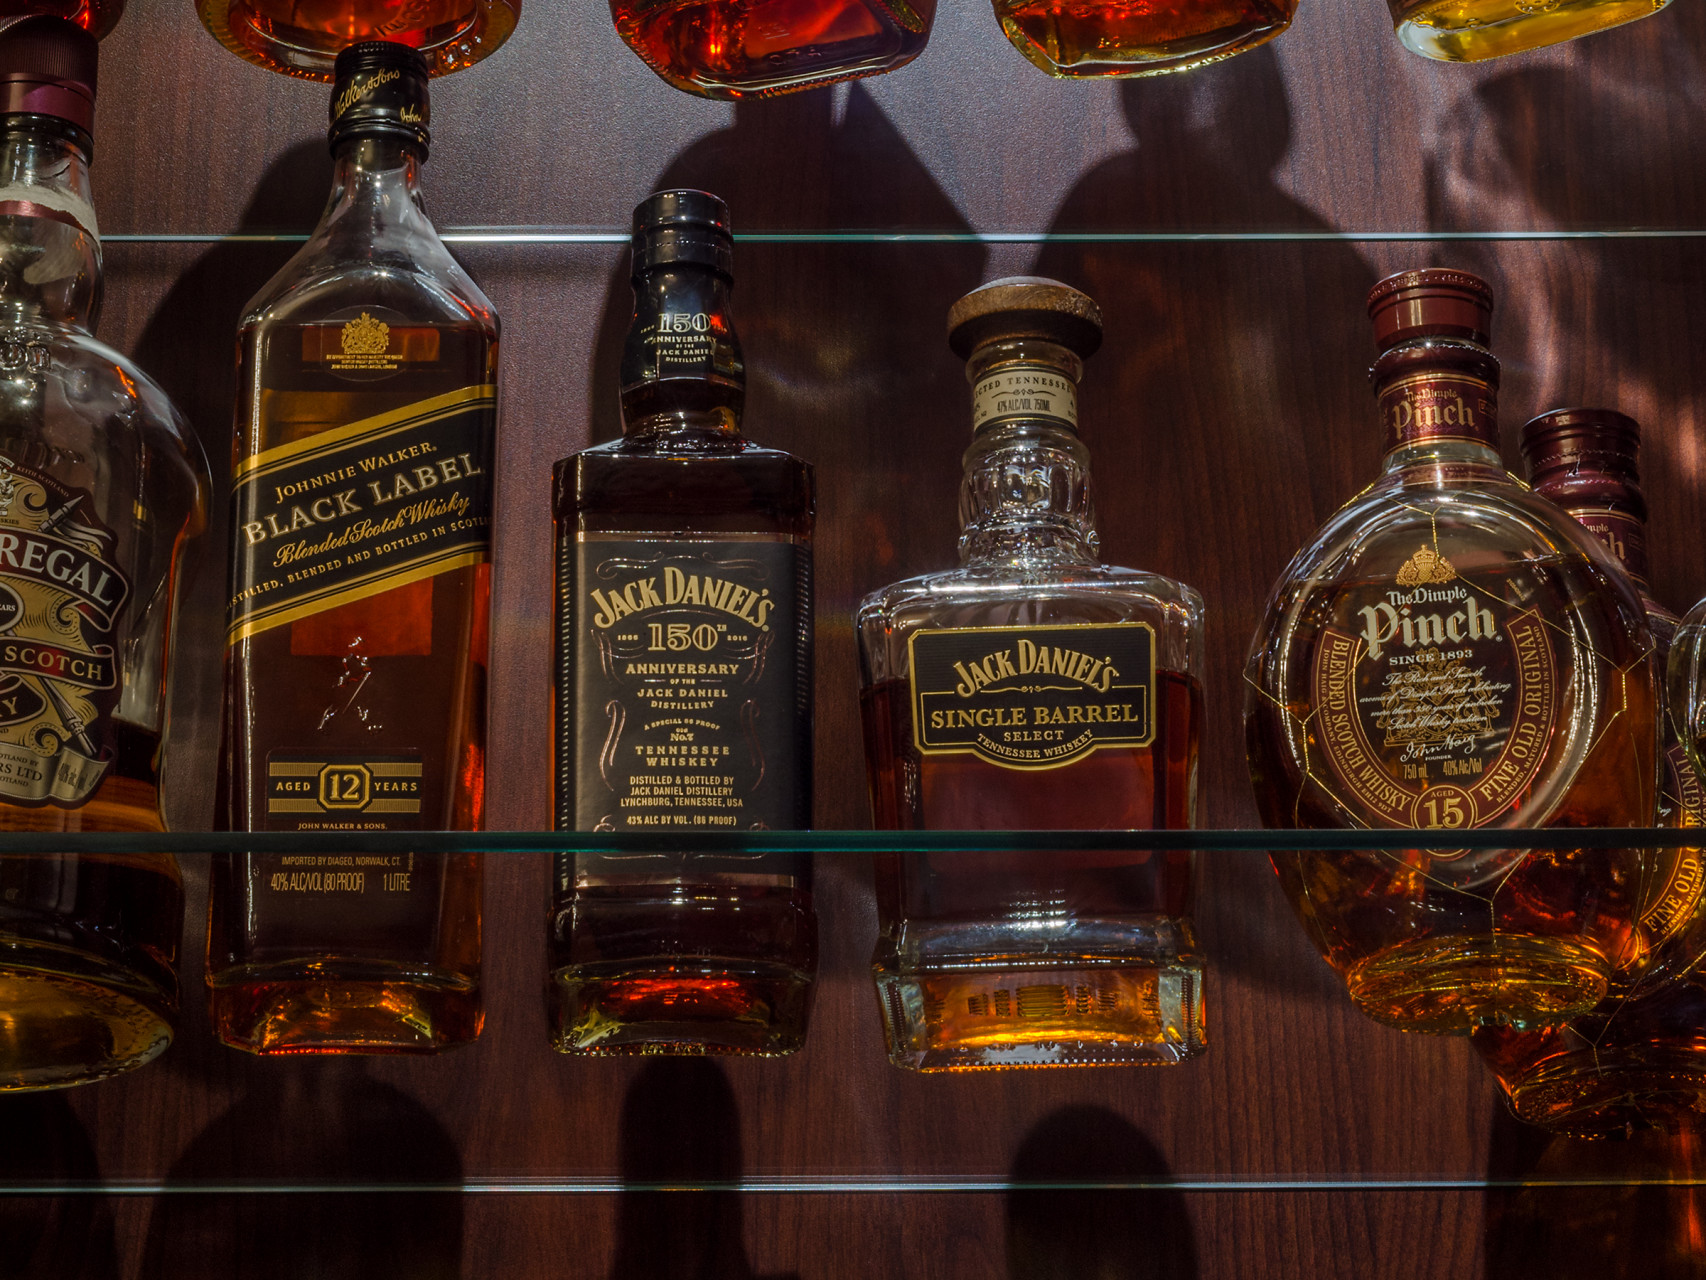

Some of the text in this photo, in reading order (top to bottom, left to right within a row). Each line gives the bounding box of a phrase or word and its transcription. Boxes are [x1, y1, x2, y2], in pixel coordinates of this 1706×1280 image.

[657, 313, 711, 333] 150
[275, 466, 355, 504] JOHNNIE
[241, 453, 481, 544] BLACK LABEL
[273, 492, 469, 568] Blended Scotch Whisky
[288, 526, 446, 583] BLENDED AND BOTTLED IN
[0, 533, 113, 606] REGAL
[591, 567, 775, 629] JACK DANIEL'S
[1386, 587, 1467, 606] The Dimple
[648, 624, 718, 651] 150
[1358, 596, 1497, 661] Pinch
[5, 646, 102, 681] SCOTCH
[626, 664, 739, 674] ANNIVERSARY
[953, 639, 1120, 697] JACK DANIEL'S
[1390, 650, 1473, 665] SINCE 1893
[638, 689, 727, 697] JACK DANIEL
[651, 701, 714, 710] DISTILLERY
[931, 704, 1138, 729] SINGLE BARREL
[1329, 640, 1411, 812] BLENDED SCOTCH WHISKY
[1480, 626, 1542, 801] FINE OLD ORIGINAL
[977, 729, 1093, 758] TENNESSEE WHISKEY
[1003, 731, 1064, 742] SELECT
[636, 746, 730, 755] TENNESSEE
[646, 758, 718, 766] WHISKEY
[276, 774, 417, 800] AGED 12 YEARS
[630, 776, 734, 784] DISTILLED & BOTTLED BY
[630, 787, 733, 795] JACK DANIEL DISTILLERY
[621, 798, 743, 807] LYNCHBURG, TENNESSEE, USA
